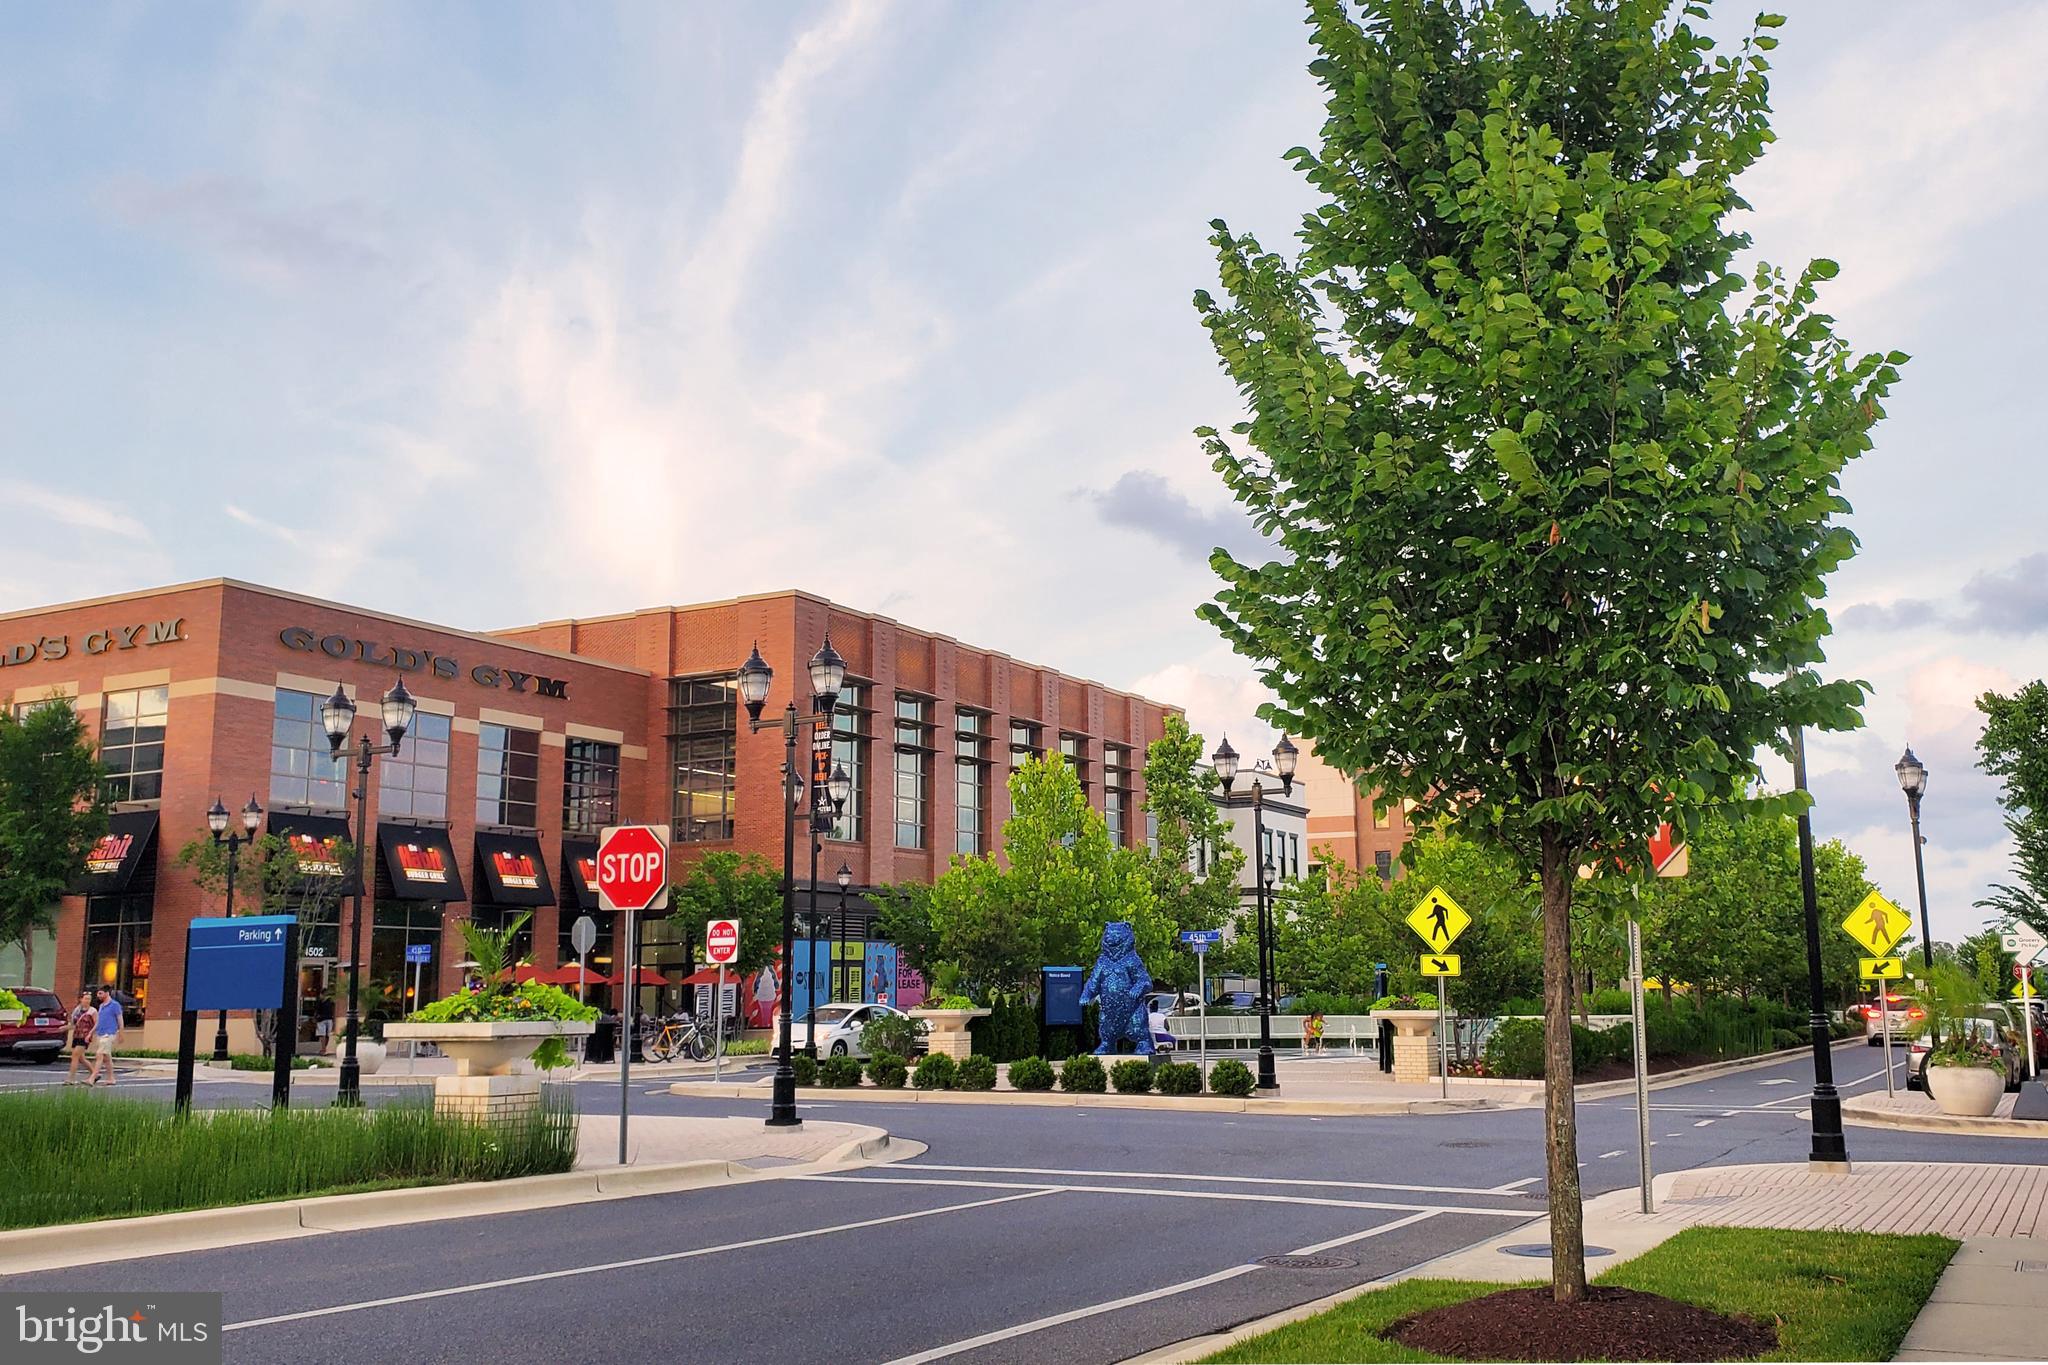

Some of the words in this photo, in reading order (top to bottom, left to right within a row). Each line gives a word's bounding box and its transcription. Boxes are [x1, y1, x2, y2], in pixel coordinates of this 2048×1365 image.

[0, 635, 69, 667] D'S
[82, 618, 186, 656] GYM
[279, 626, 460, 680] GOLD'S
[471, 664, 570, 700] GYM
[602, 852, 660, 884] STOP
[239, 929, 272, 942] Parking
[712, 929, 721, 937] DO
[722, 929, 733, 937] NOT
[713, 947, 731, 955] ENTER
[898, 968, 913, 978] FOR
[2014, 968, 2031, 976] STP
[898, 979, 921, 989] LEASE
